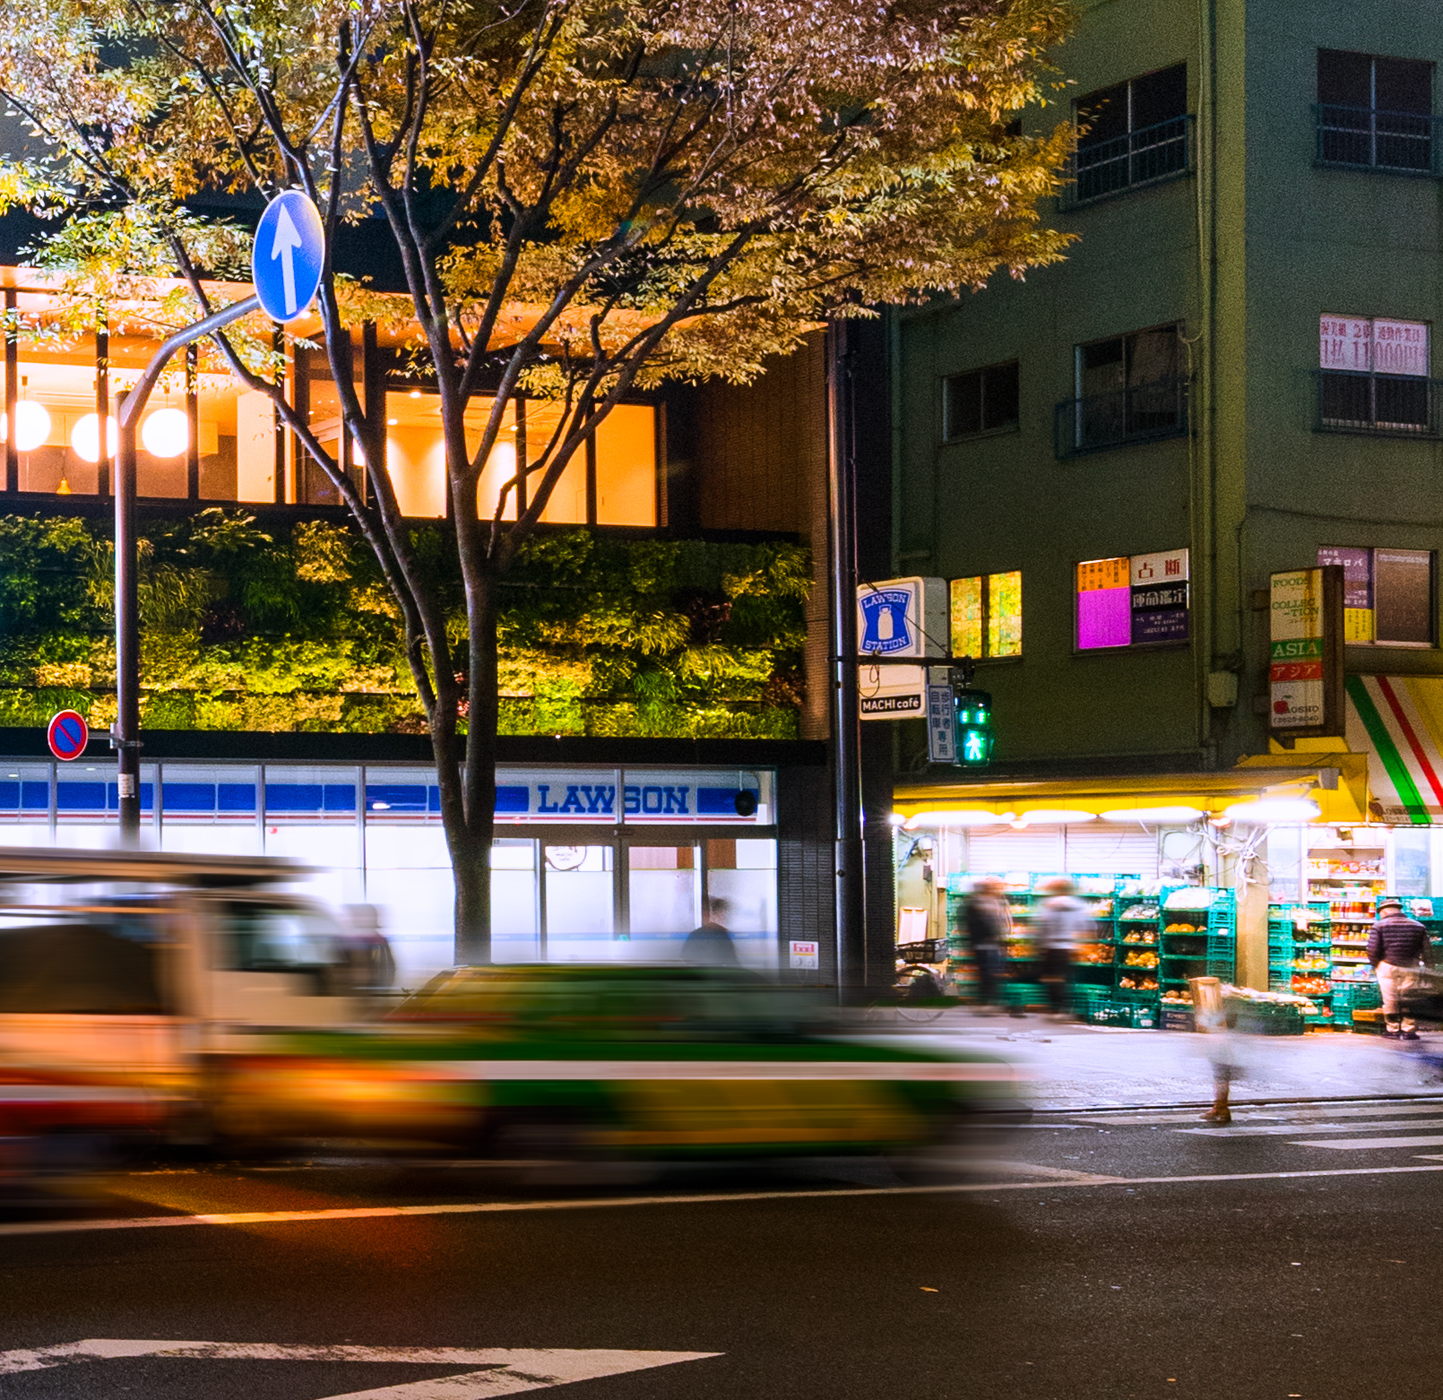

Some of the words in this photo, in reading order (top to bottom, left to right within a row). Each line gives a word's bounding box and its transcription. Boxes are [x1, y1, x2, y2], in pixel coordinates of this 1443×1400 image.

[862, 593, 907, 609] LAWSON
[864, 636, 907, 651] STATION
[1273, 641, 1318, 658] ASIA
[862, 699, 895, 711] MACHI
[897, 697, 919, 709] café
[537, 784, 690, 814] LAWSON
